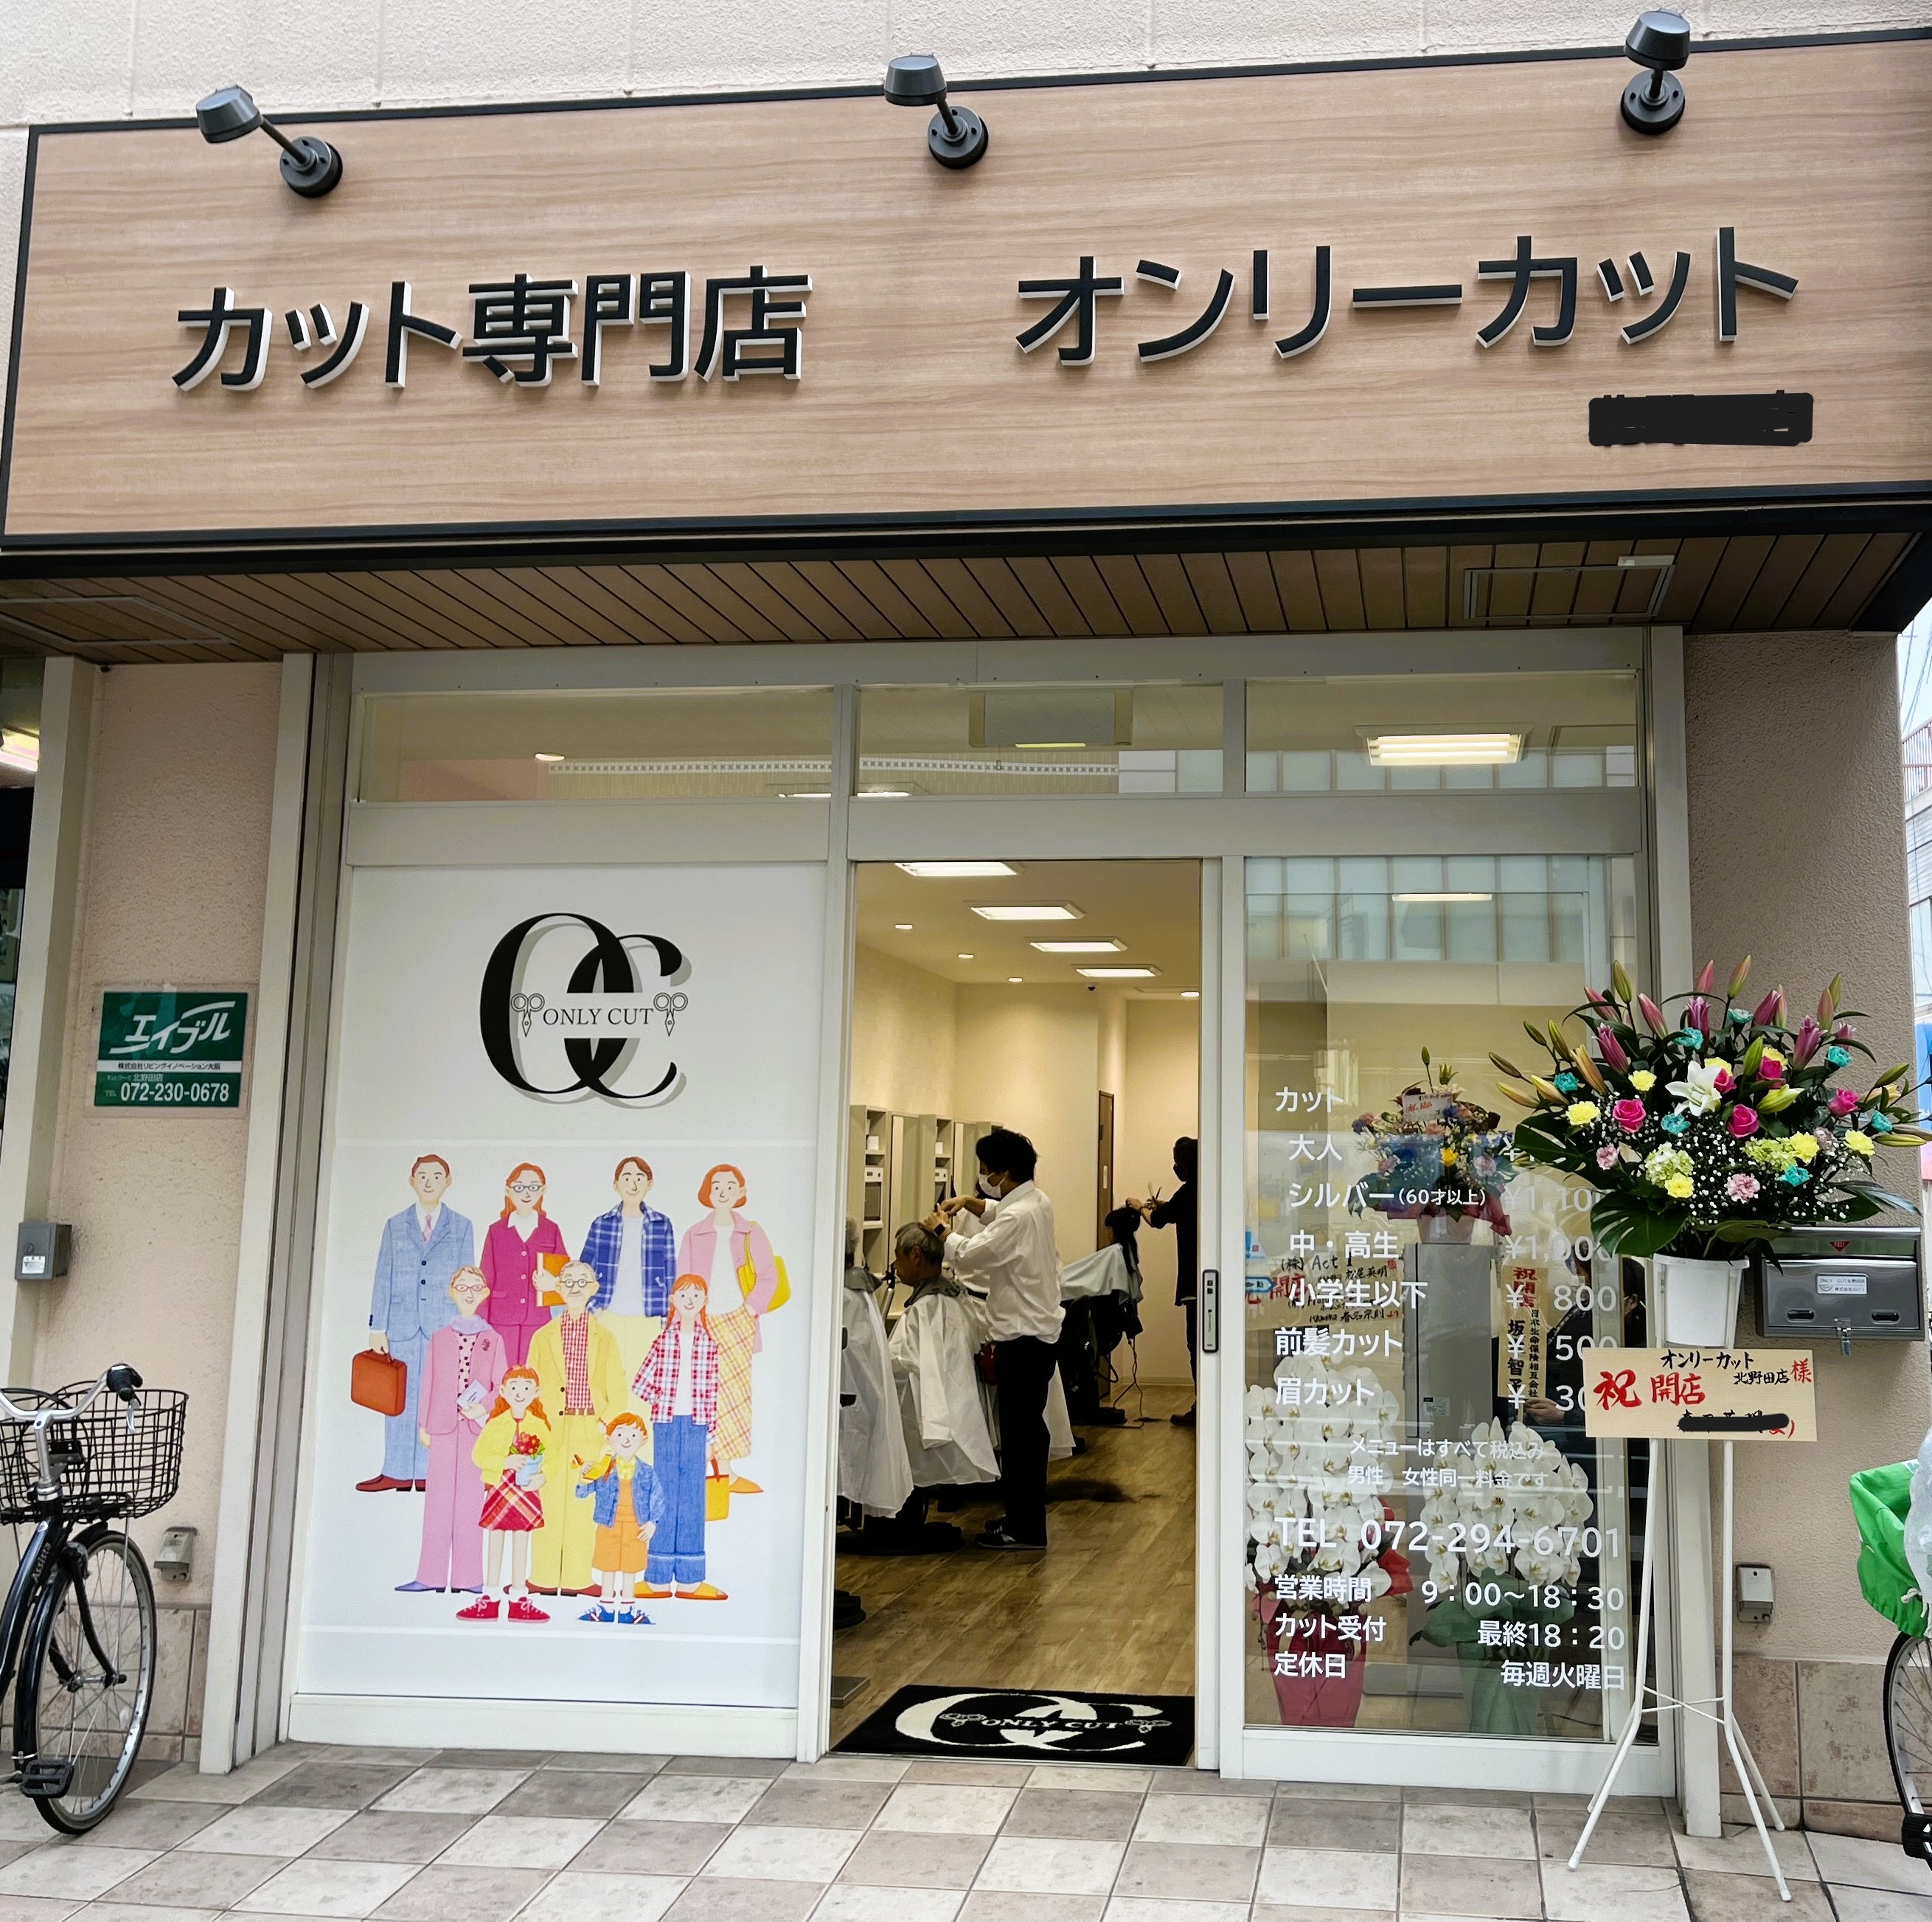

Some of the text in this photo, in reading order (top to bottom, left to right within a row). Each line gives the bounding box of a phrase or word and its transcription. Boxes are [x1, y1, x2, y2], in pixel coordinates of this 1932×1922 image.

[171, 226, 1800, 391] カット専門店 オンリーカット
[109, 1001, 236, 1053] エイブル
[543, 1008, 654, 1025] ONLY CUT
[120, 1083, 229, 1102] 072-230-0678
[1276, 1086, 1344, 1112] カット
[1289, 1134, 1343, 1161] 大人
[1504, 1186, 1605, 1212] ¥1,10
[1290, 1229, 1399, 1258] 中・高生
[1289, 1278, 1428, 1309] 小学生以下
[1506, 1284, 1524, 1309] ¥
[1554, 1285, 1617, 1311] 800
[1275, 1327, 1403, 1357] 前髪カット
[1660, 1349, 1754, 1370] オンリーカット
[1733, 1358, 1812, 1385] 北野田店 様
[1276, 1377, 1374, 1406] 眉カット
[1593, 1369, 1706, 1410] 祝 開店
[1350, 1437, 1543, 1460] メニューはすべて税込み
[1275, 1518, 1619, 1558] TEL 072-294-6701
[1275, 1575, 1372, 1602] 営業時間
[1275, 1615, 1386, 1642] カット受付
[1275, 1652, 1625, 1691] 定休日 毎週火曜日
[981, 1719, 1057, 1727] ONLY
